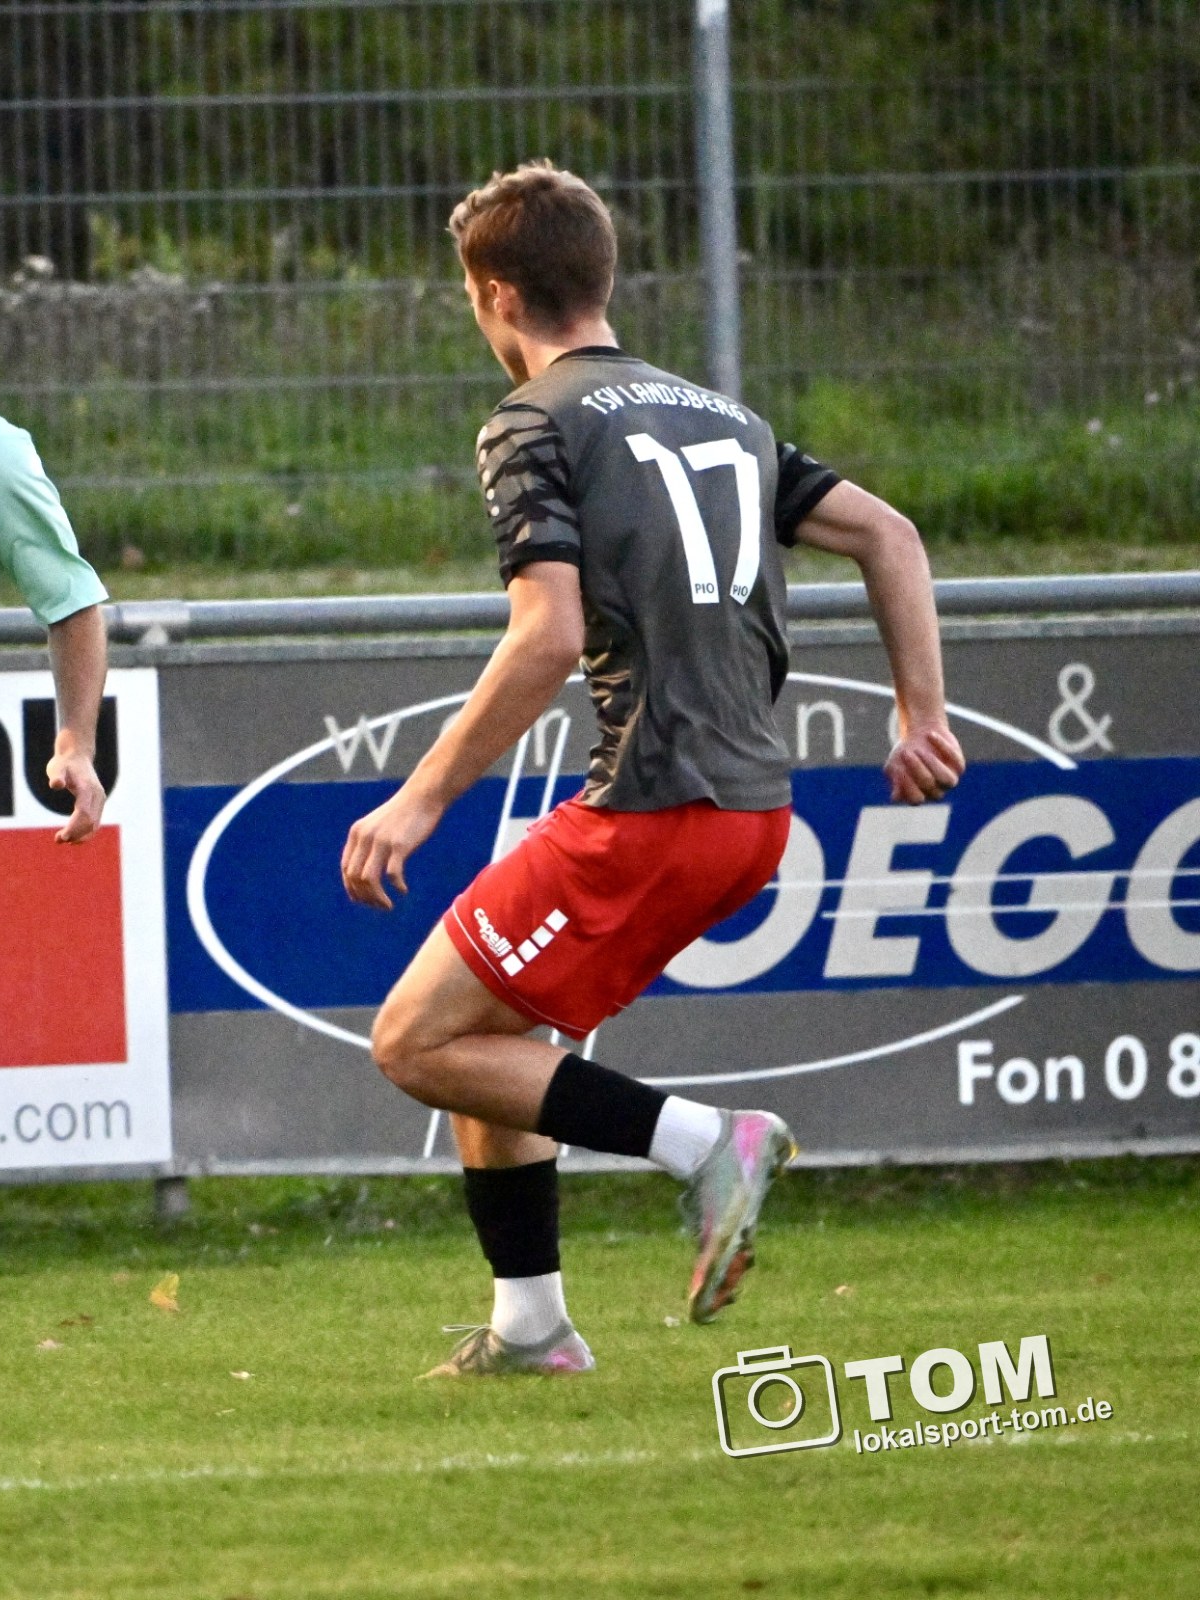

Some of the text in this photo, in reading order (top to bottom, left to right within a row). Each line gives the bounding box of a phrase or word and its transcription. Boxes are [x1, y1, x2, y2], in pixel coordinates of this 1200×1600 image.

[581, 382, 748, 425] TSV LANDSBERG
[625, 433, 761, 606] 17
[694, 582, 715, 595] PIO
[1048, 662, 1115, 754] &
[956, 1038, 1086, 1105] Fon
[1105, 1034, 1148, 1100] 0
